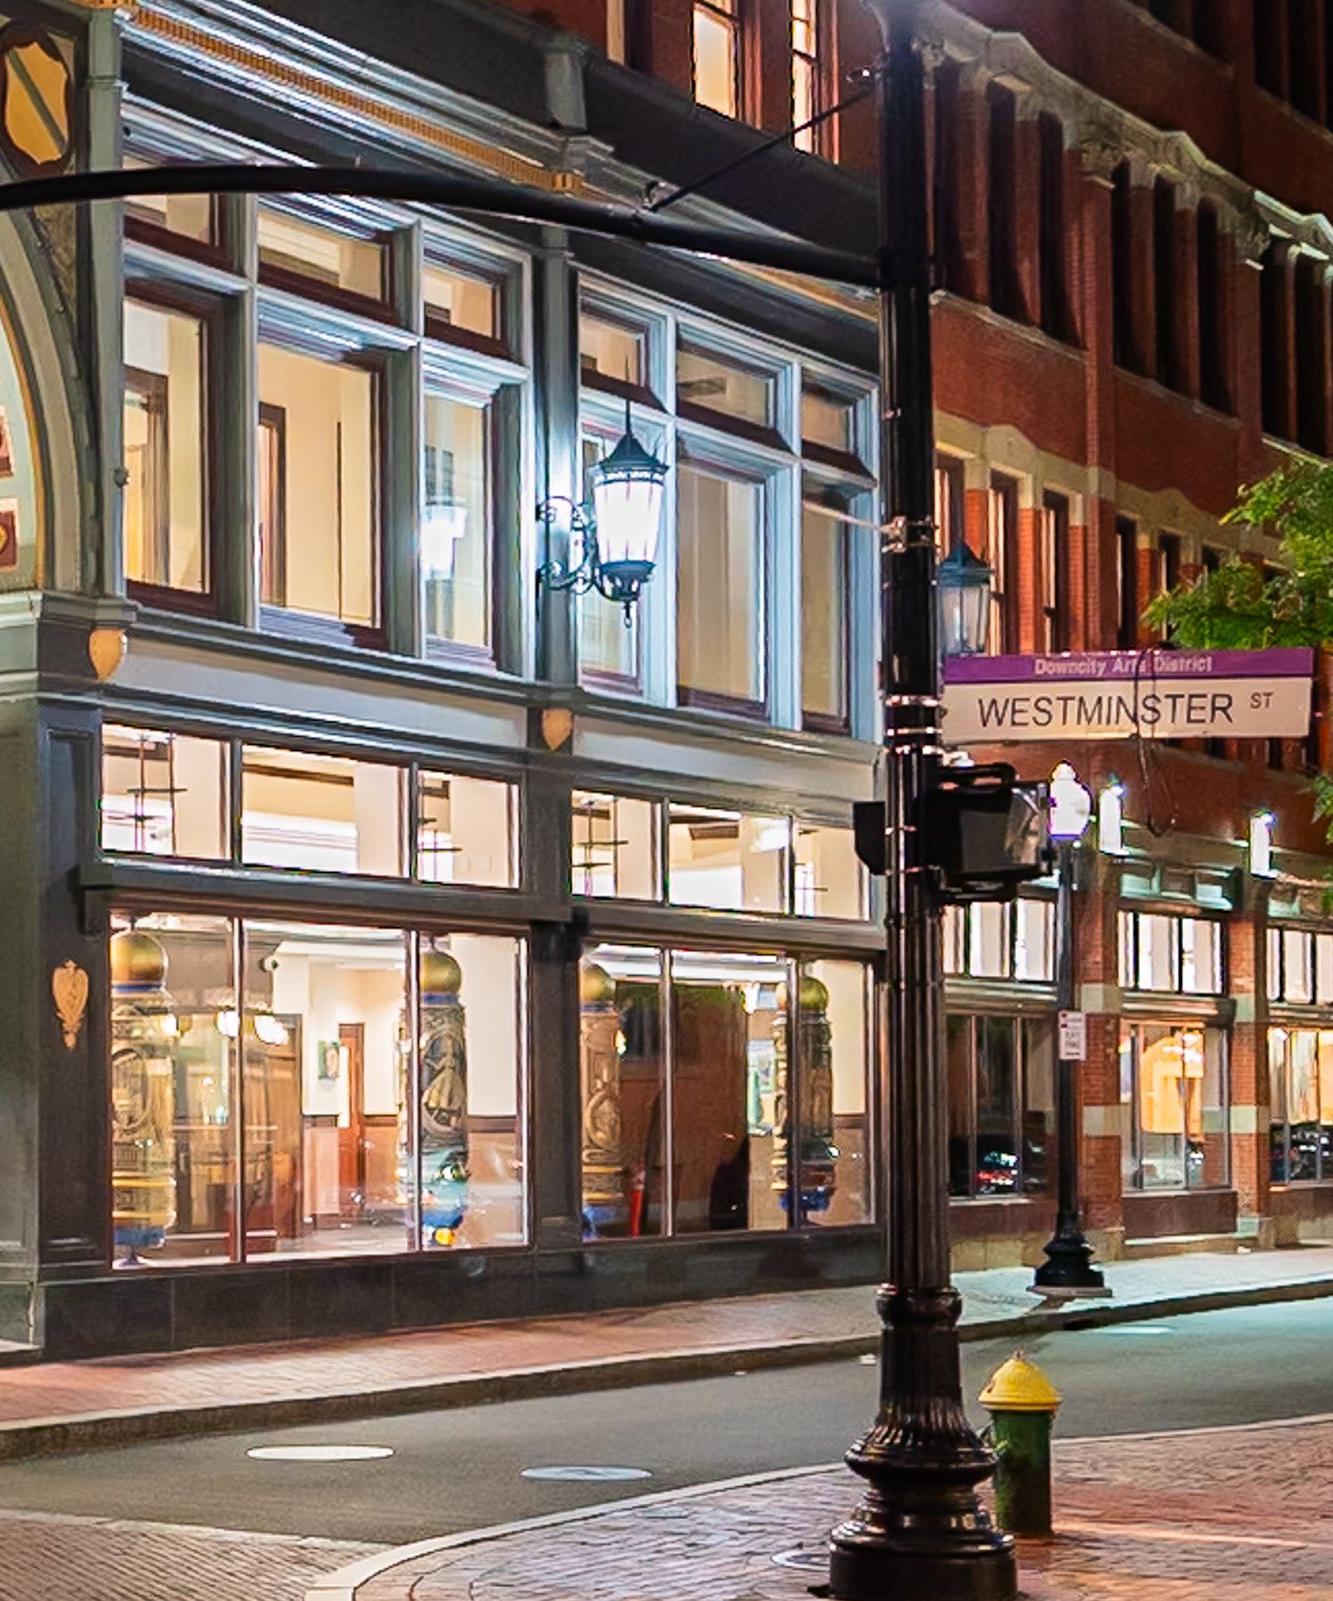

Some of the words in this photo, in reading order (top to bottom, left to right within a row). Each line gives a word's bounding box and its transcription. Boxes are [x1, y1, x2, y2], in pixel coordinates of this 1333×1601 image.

[1035, 657, 1106, 676] Downcity
[1153, 655, 1213, 674] District
[978, 693, 1234, 728] WESTMINSTER
[1249, 691, 1275, 710] ST
